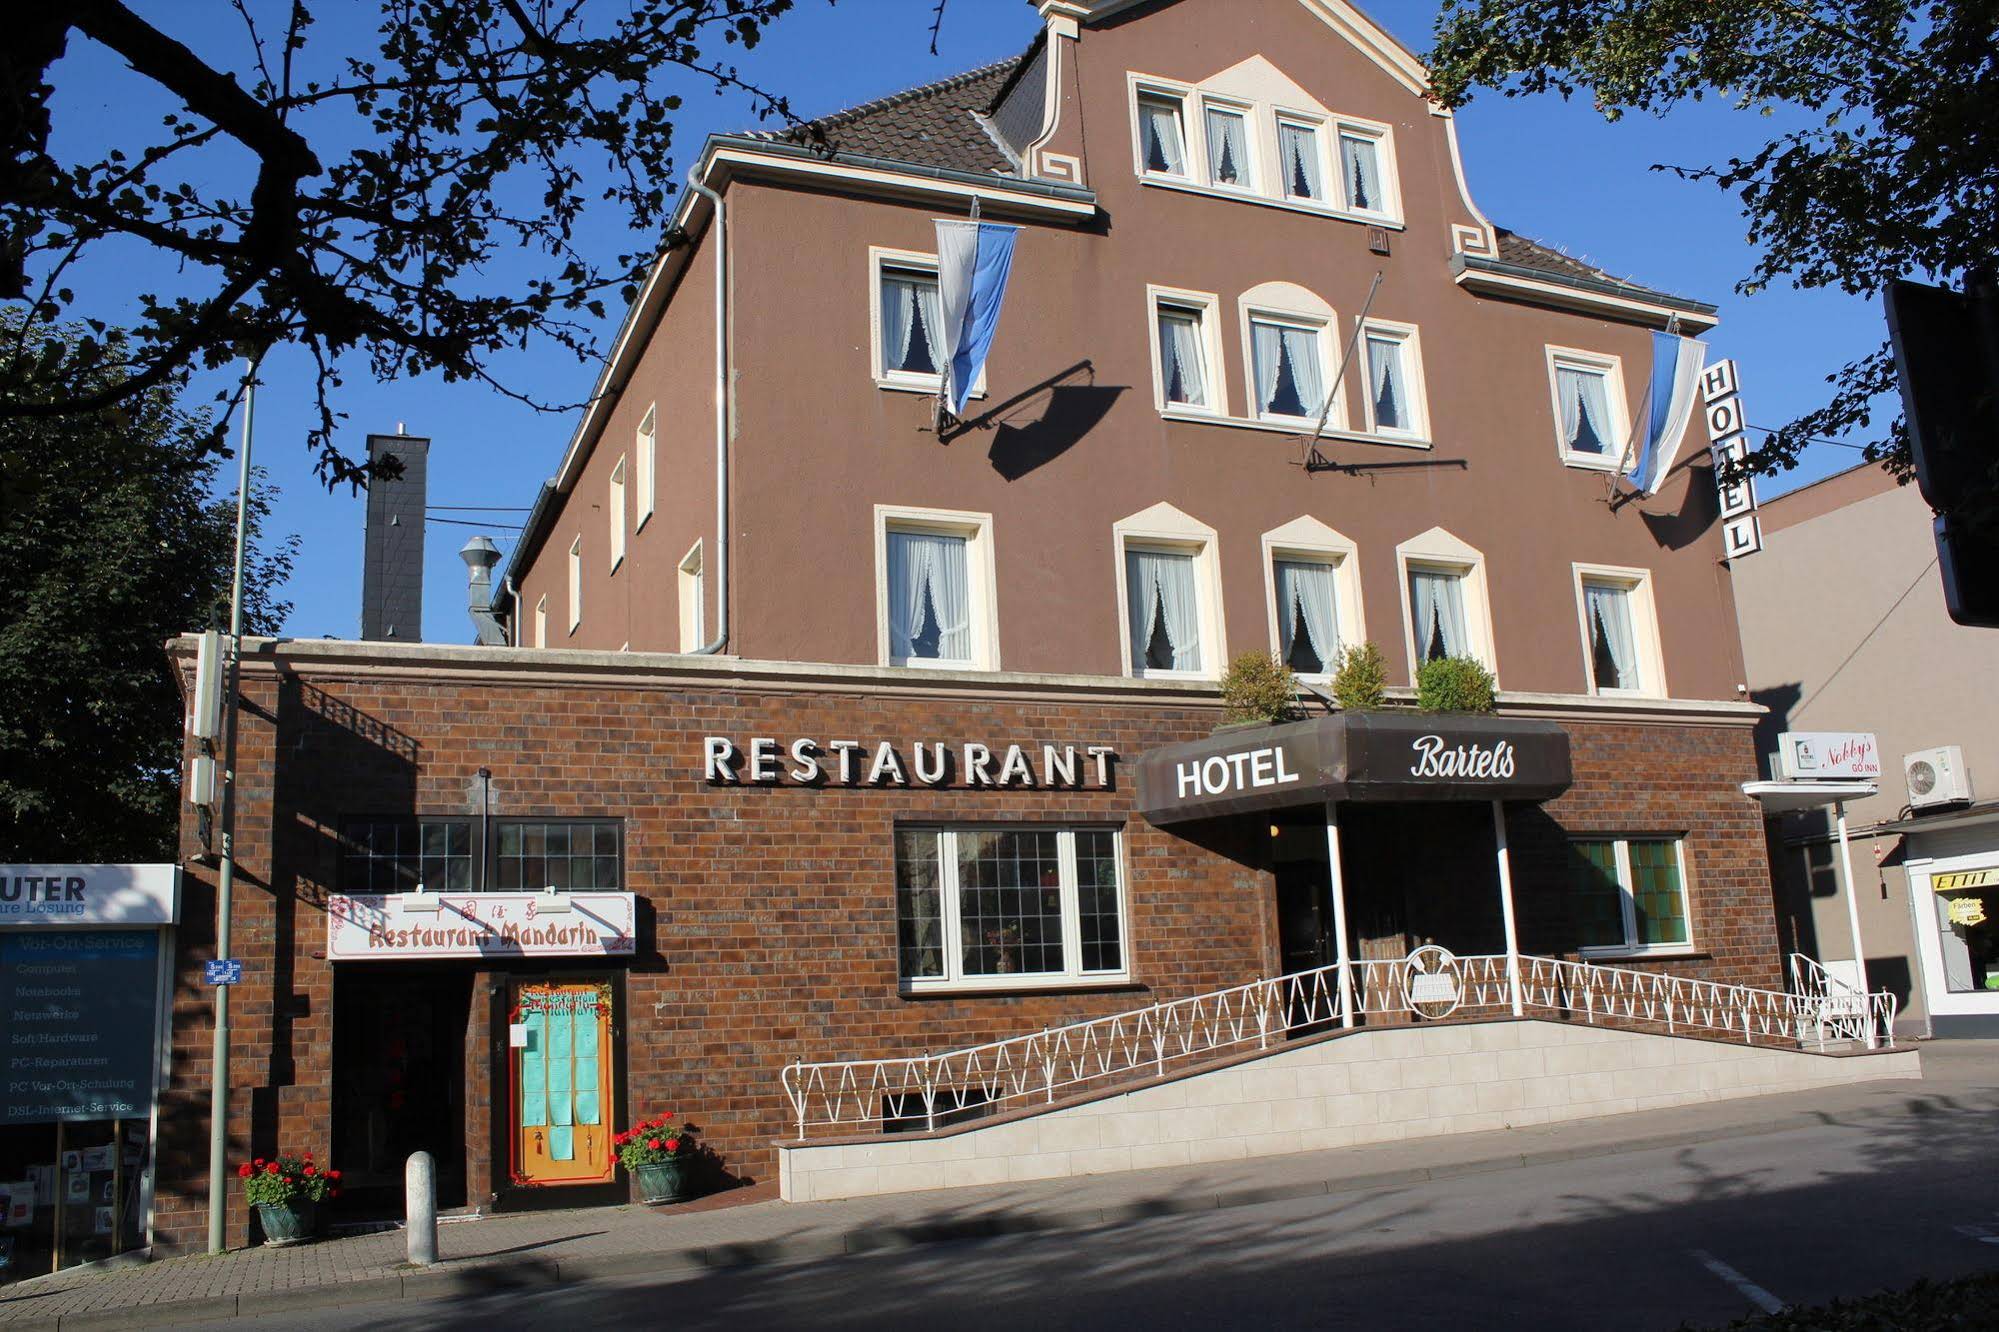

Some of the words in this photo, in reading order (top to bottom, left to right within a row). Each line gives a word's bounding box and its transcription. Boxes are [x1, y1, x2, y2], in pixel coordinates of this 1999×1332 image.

[1705, 366, 1749, 551] HOTEL
[703, 736, 1114, 787] RESTAURANT
[1410, 734, 1515, 779] Bartels
[1852, 763, 1863, 773] GO
[1864, 763, 1878, 773] INN
[1176, 745, 1300, 799] HOTEL
[0, 876, 86, 902] UTER
[25, 901, 85, 916] Lösung
[368, 921, 491, 950] Restaurant
[501, 920, 599, 949] Mandarin
[11, 1056, 109, 1069] PC-Reparaturen
[9, 1081, 29, 1093] PC
[31, 1078, 135, 1092] Vor-Ort-Schulung
[8, 1101, 134, 1117] DSL-Internet-Service
